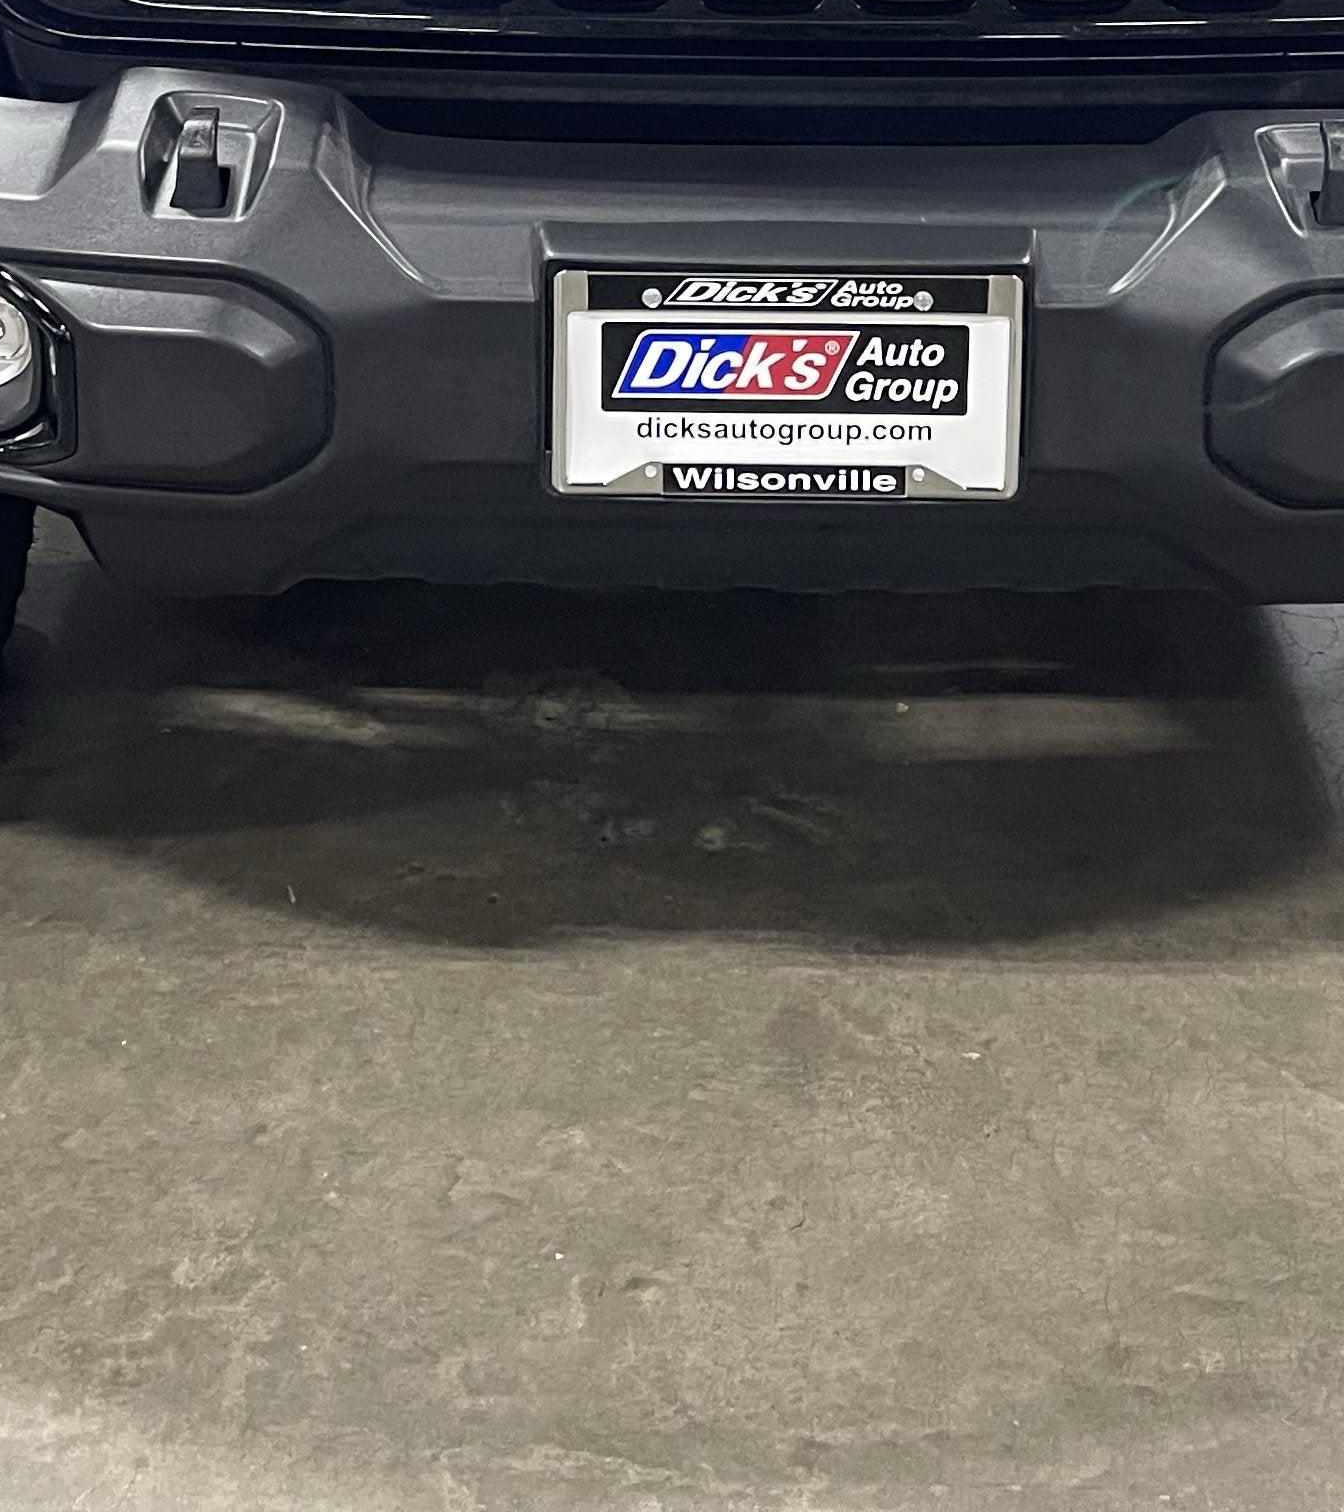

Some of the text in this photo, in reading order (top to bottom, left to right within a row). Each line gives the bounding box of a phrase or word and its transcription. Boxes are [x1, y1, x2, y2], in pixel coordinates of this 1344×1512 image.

[675, 281, 819, 304] Dick's
[836, 279, 904, 295] Auto
[830, 292, 915, 310] Group
[631, 338, 827, 391] Dick's
[856, 337, 946, 368] Auto
[844, 371, 959, 410] Group
[636, 417, 933, 445] dicksautogroup.com
[672, 467, 898, 493] Wilsonville
